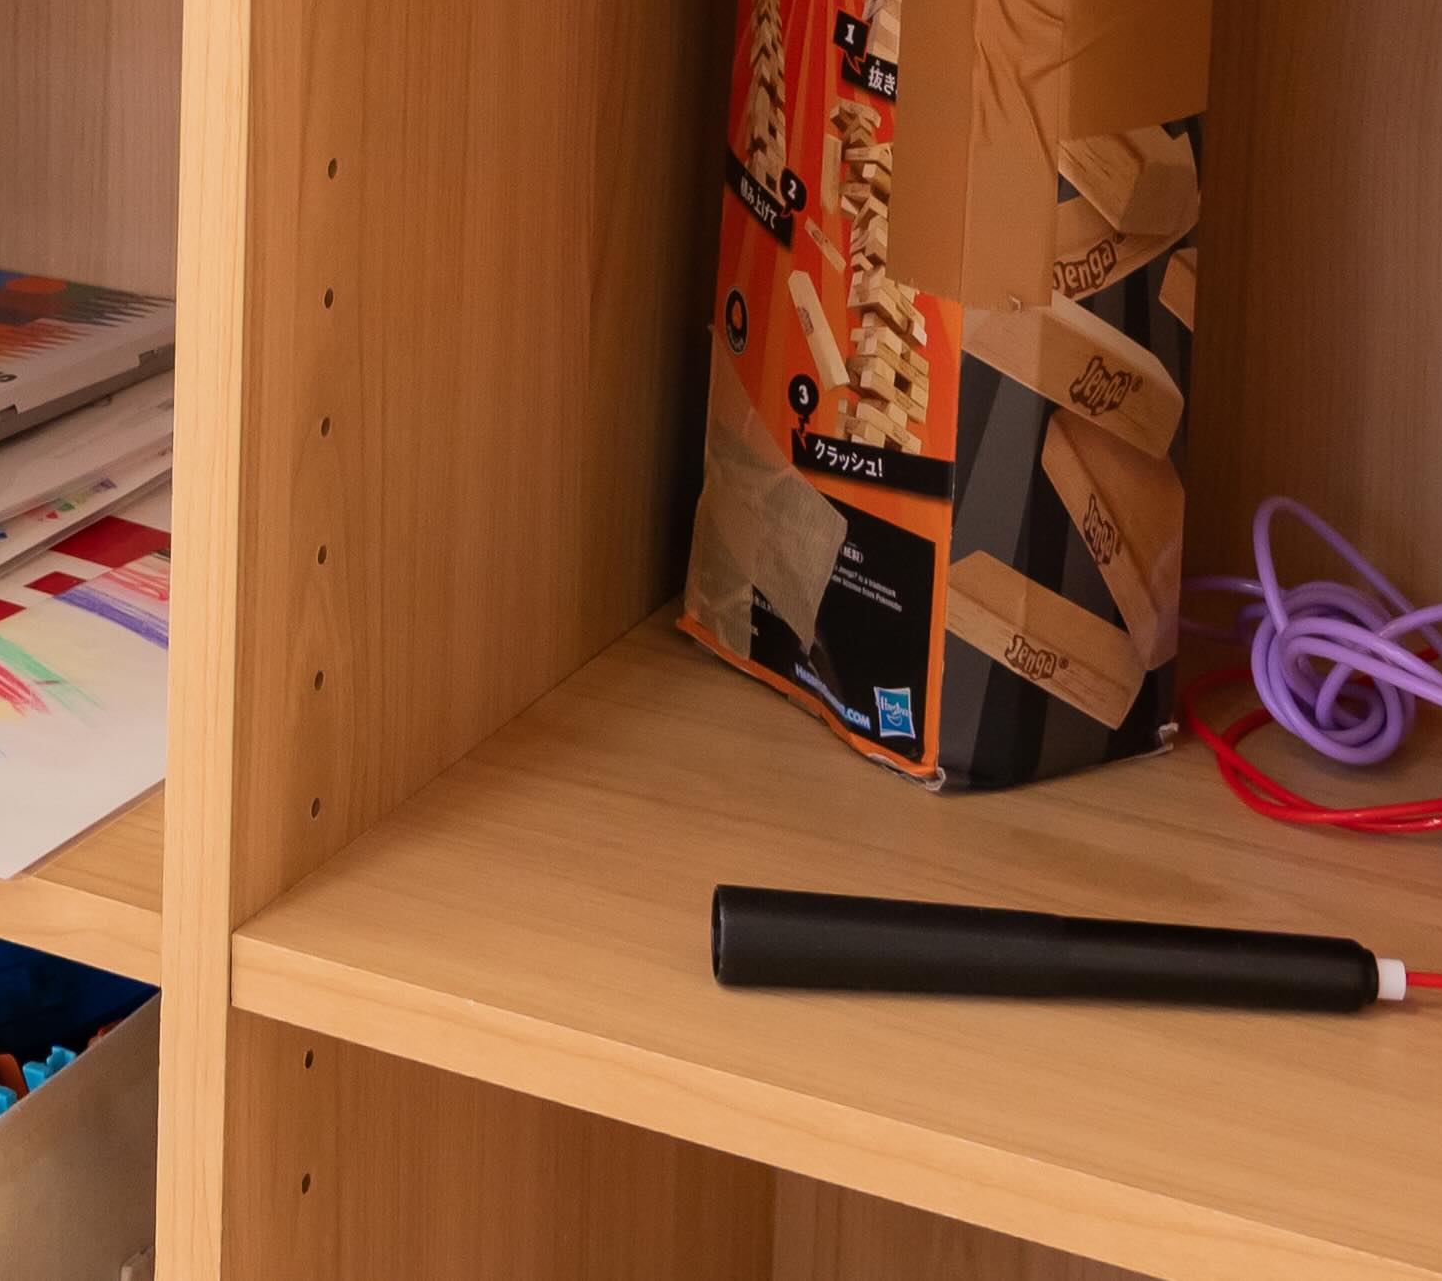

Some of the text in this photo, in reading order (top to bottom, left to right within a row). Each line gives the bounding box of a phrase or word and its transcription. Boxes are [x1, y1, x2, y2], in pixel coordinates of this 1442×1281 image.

[844, 23, 856, 45] 1
[787, 178, 797, 200] 2
[798, 384, 810, 405] 3
[814, 438, 884, 478] クラッシュ!
[1084, 494, 1116, 566] Jenga
